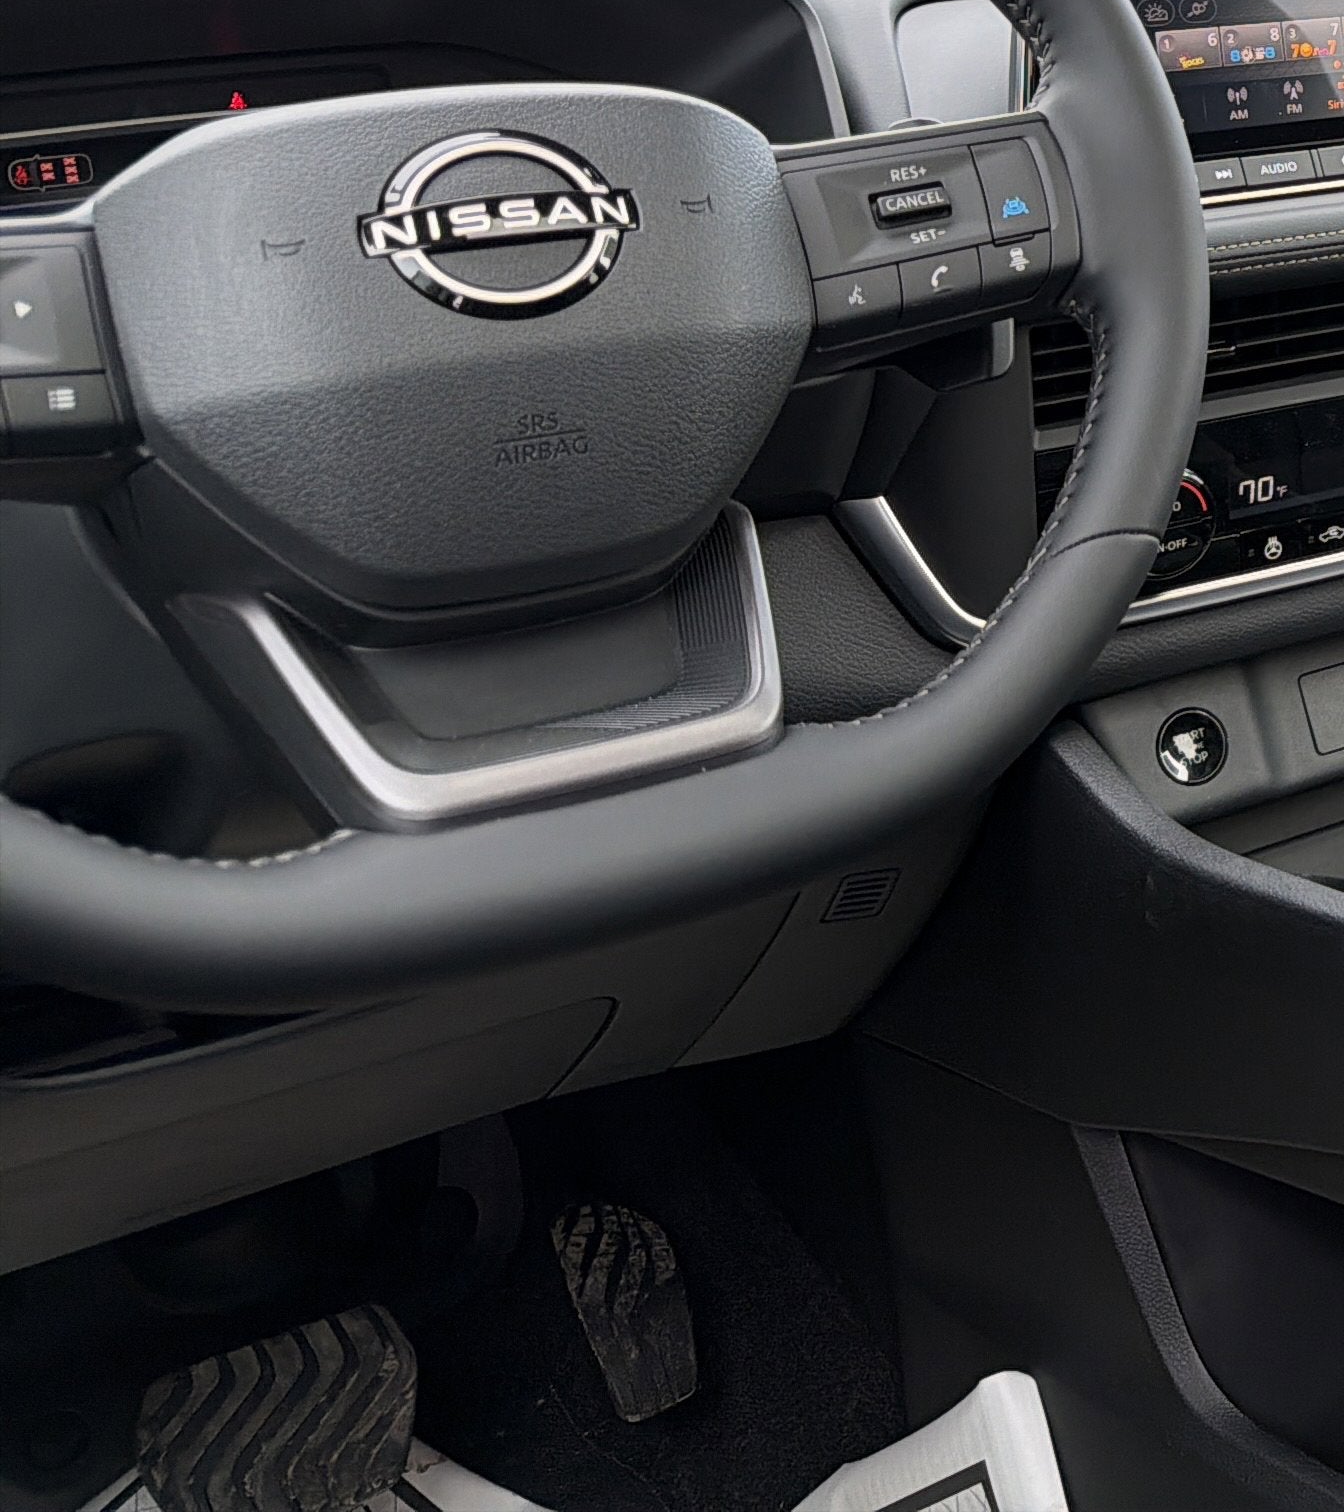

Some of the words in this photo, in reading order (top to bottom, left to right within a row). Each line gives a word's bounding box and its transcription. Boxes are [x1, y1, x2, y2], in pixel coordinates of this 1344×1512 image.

[1269, 27, 1280, 42] 8
[1289, 28, 1297, 39] 3
[1330, 23, 1339, 36] 7
[1207, 33, 1218, 47] 6
[1227, 34, 1235, 44] 2
[1229, 109, 1249, 121] AM
[1286, 103, 1303, 115] FM
[890, 165, 928, 182] RES+
[1260, 161, 1298, 176] AUDIO
[885, 191, 945, 211] CANCEL
[369, 195, 631, 250] NISSAN
[516, 410, 560, 435] SRS
[494, 437, 590, 468] AIRBAG
